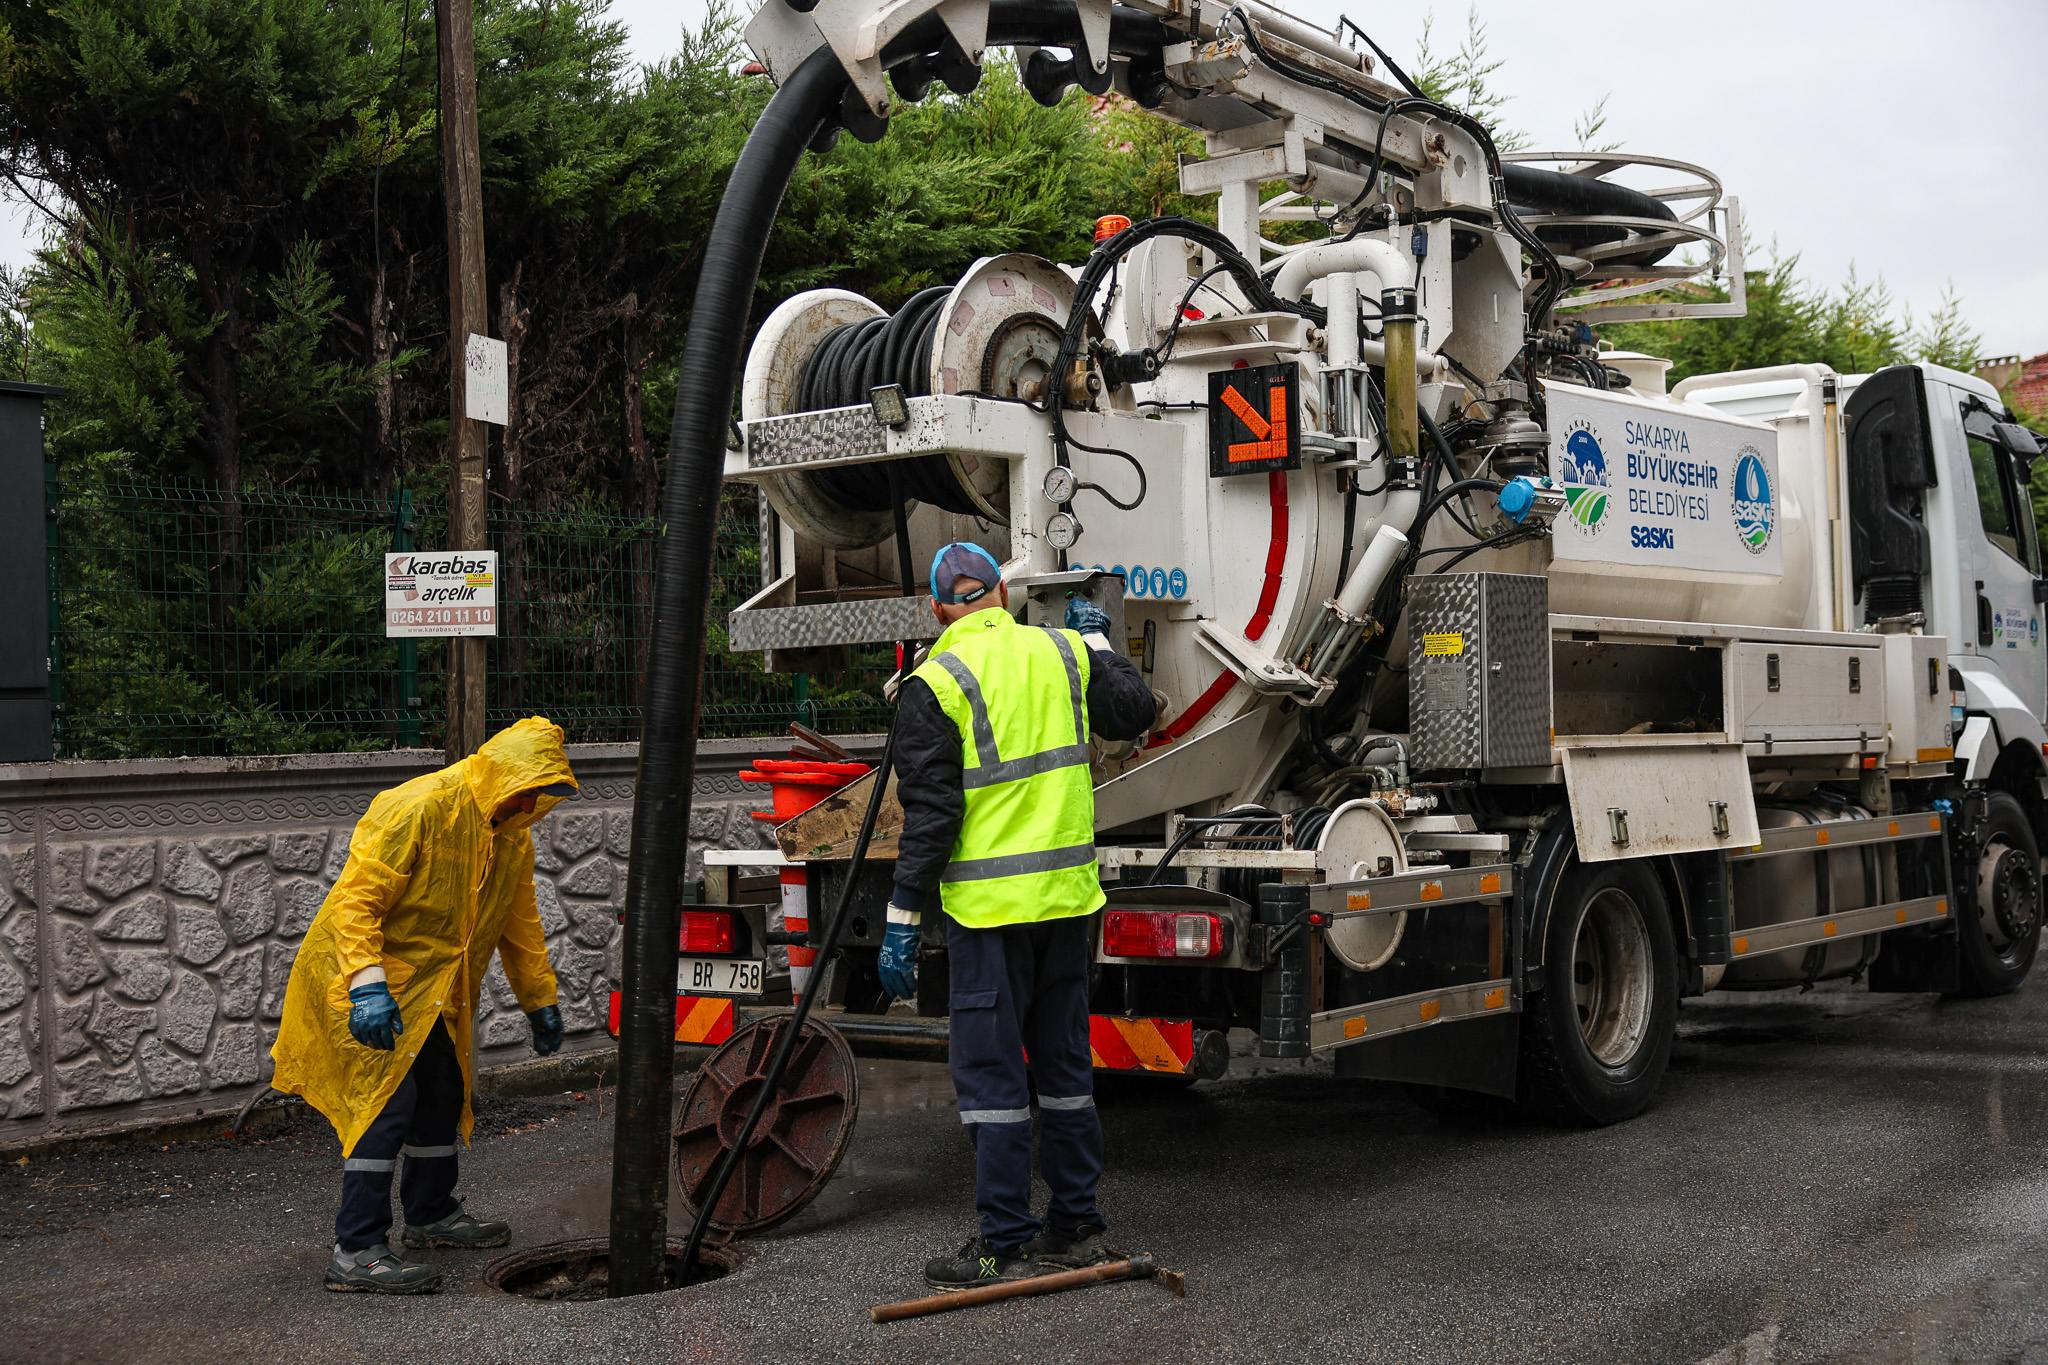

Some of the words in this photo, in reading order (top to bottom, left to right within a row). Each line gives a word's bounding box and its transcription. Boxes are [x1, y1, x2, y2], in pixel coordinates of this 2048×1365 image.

[812, 414, 877, 436] MAKIN
[1625, 420, 1690, 454] SAKARYA
[1627, 450, 1718, 489] BÜYÜKŞEHİR
[1629, 488, 1709, 521] BELEDİYESİ
[391, 611, 423, 624] 0264
[427, 610, 451, 623] 210
[456, 610, 470, 623] 11
[475, 609, 491, 622] 10
[693, 961, 713, 987] BR
[729, 963, 760, 990] 758
